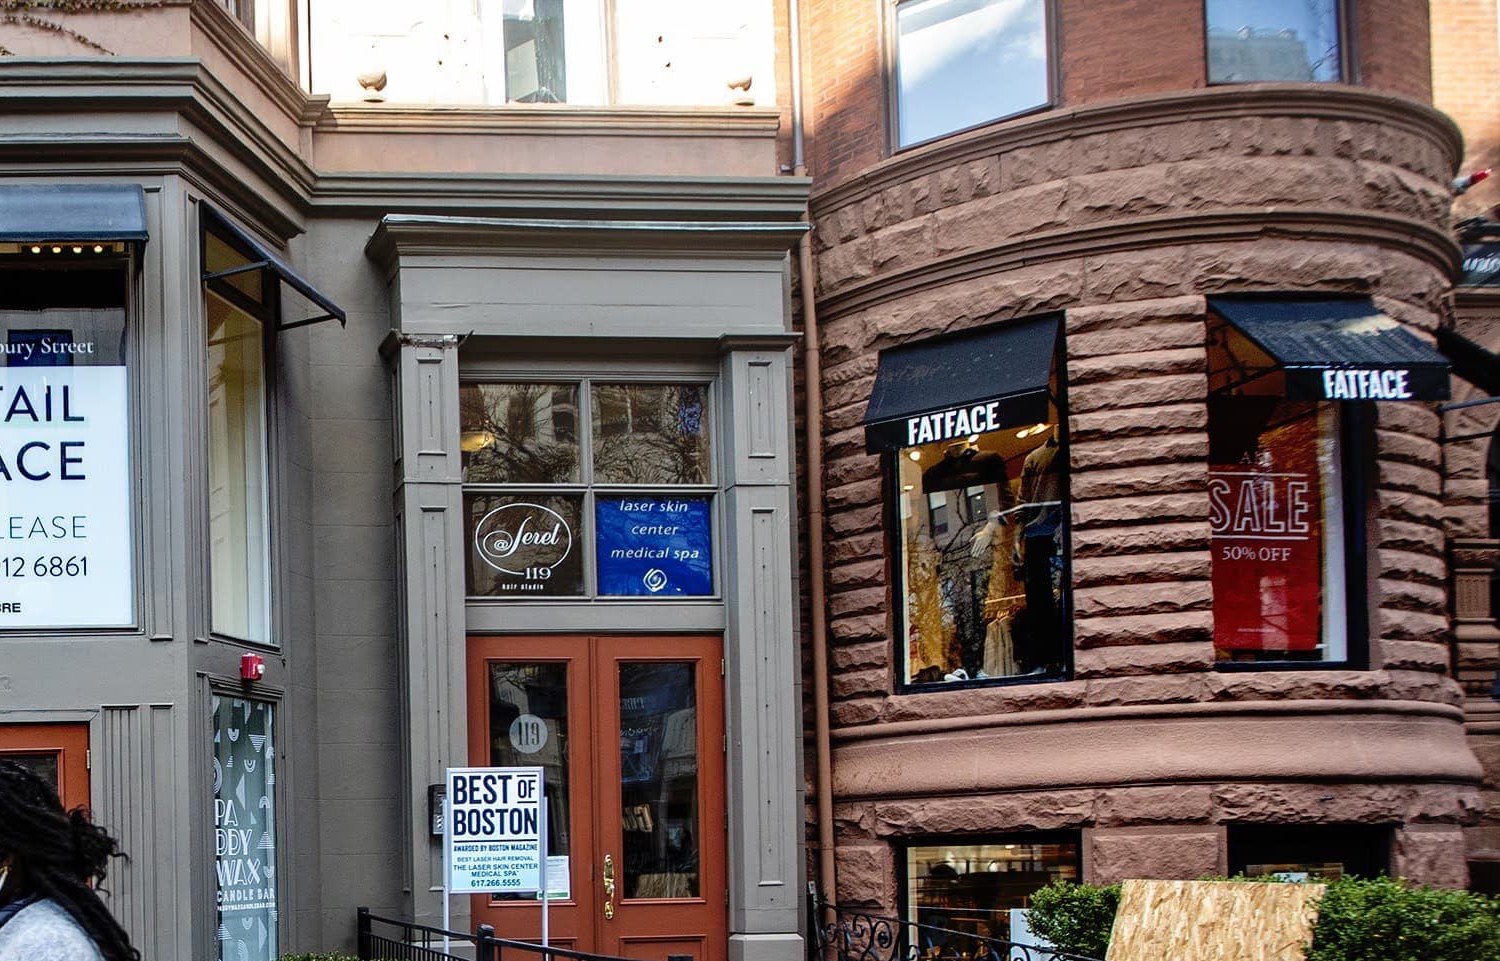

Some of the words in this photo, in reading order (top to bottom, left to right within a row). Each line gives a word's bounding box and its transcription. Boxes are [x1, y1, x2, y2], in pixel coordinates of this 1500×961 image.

[41, 337, 94, 354] Street
[1323, 369, 1413, 399] FATFACE
[908, 402, 1000, 446] FATFACE
[619, 500, 655, 512] laser
[659, 500, 688, 512] skin
[1208, 478, 1309, 533] SALE
[631, 525, 679, 535] center
[610, 547, 669, 558] medical
[673, 549, 700, 561] spa
[1222, 546, 1256, 560] 50%
[1258, 547, 1291, 561] OFF
[33, 556, 88, 577] 6861
[525, 567, 551, 580] 119
[518, 722, 540, 746] 119
[453, 775, 512, 805] BEST
[517, 780, 536, 799] OF
[453, 808, 537, 836] BOSTON
[216, 858, 260, 886] WAX
[471, 879, 521, 887] 617.266.5555
[217, 890, 254, 902] CANDLE
[258, 888, 275, 899] BAR
